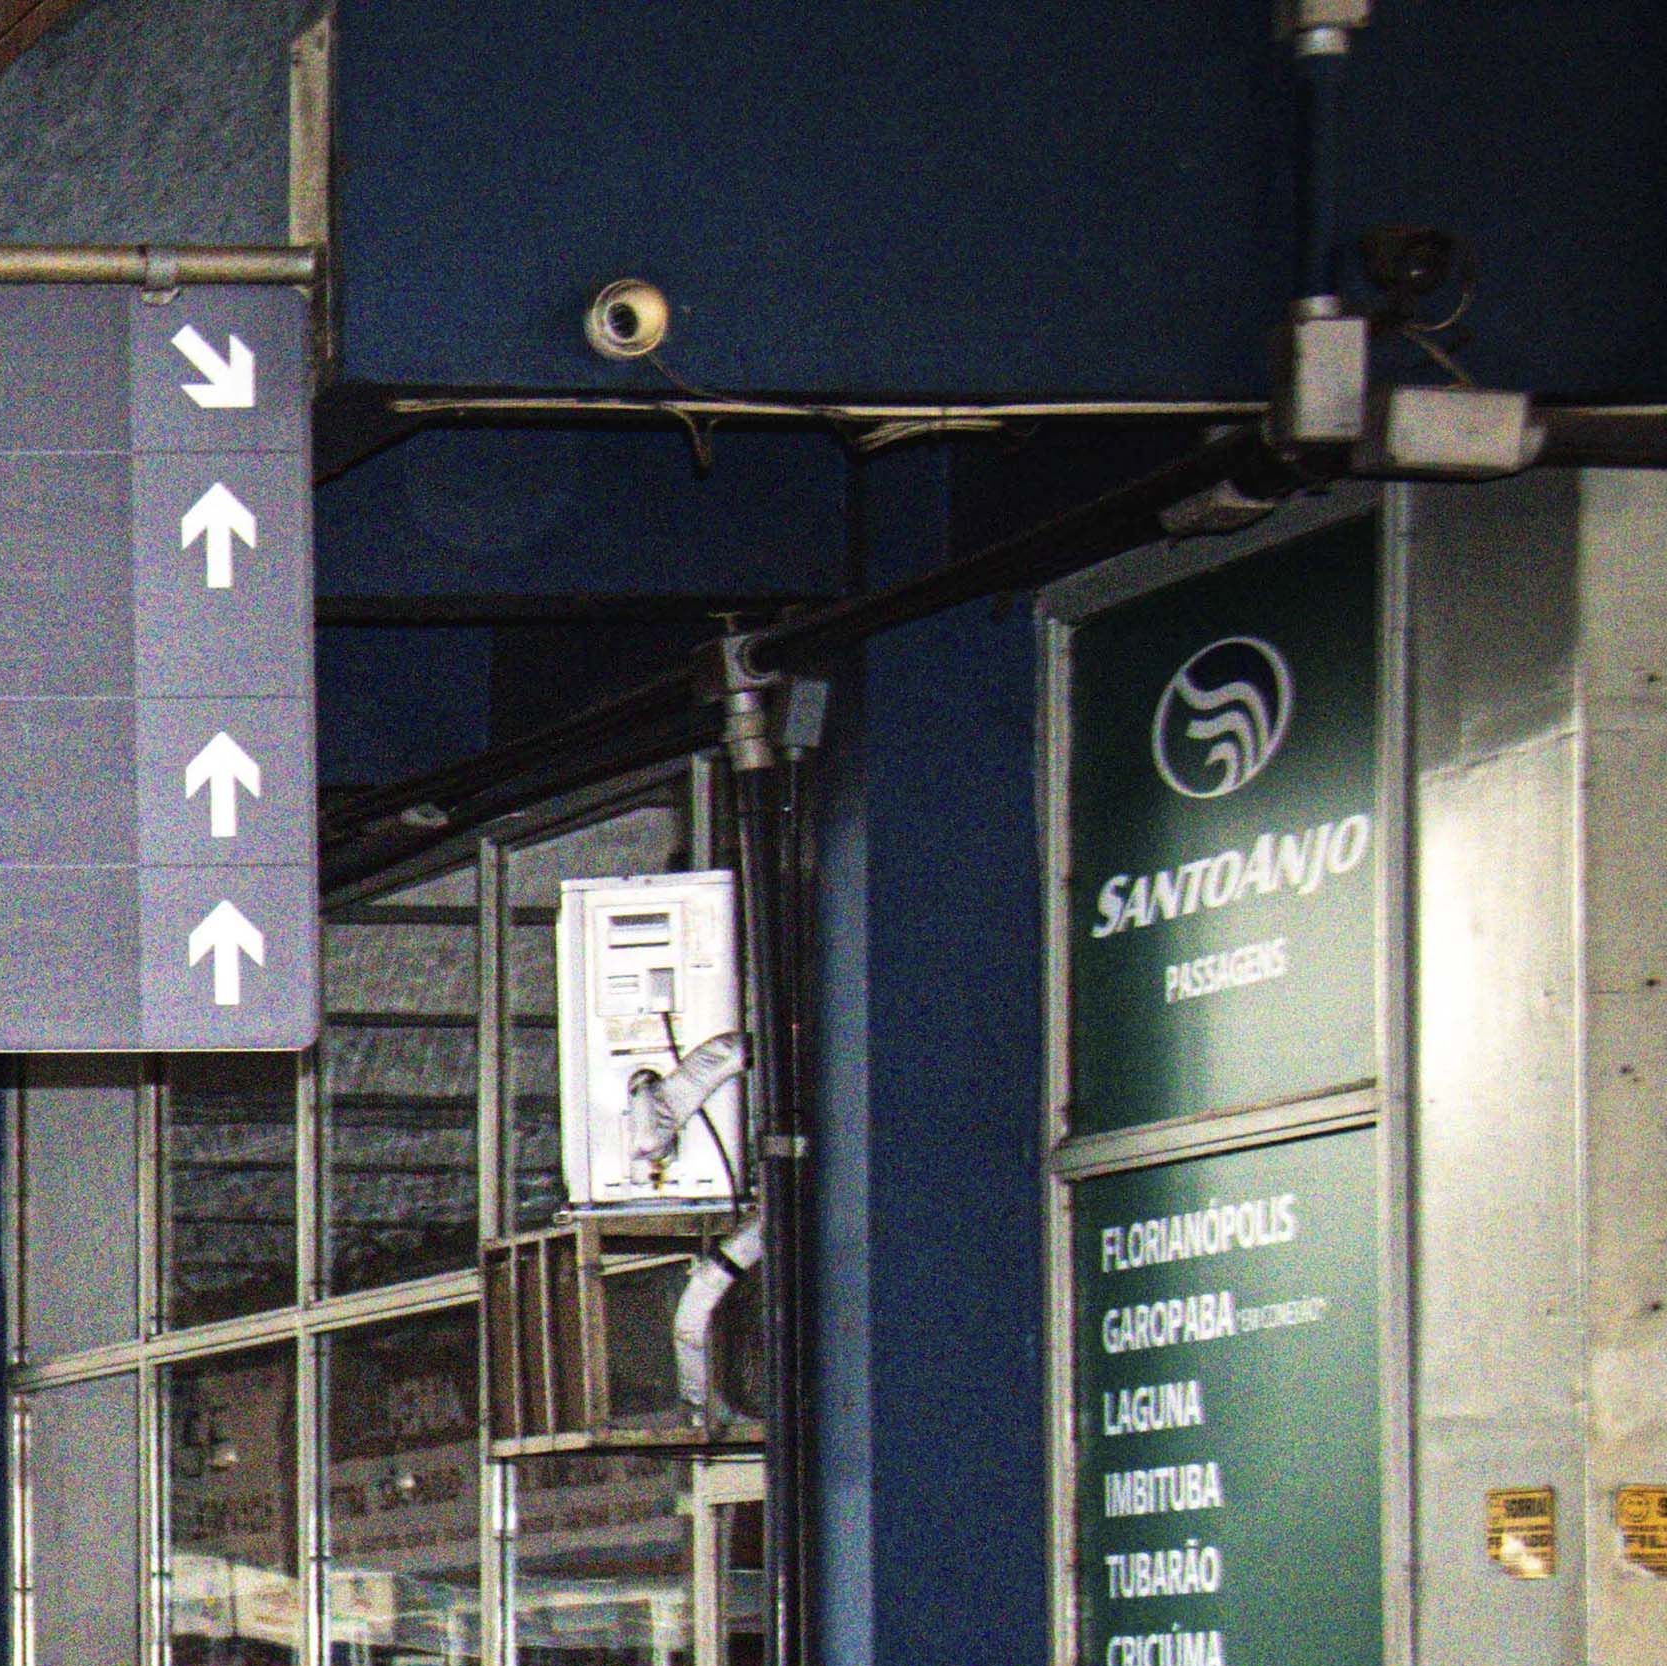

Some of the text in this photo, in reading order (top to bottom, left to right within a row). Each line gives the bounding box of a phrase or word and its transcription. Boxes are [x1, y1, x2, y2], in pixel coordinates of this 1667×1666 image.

[1166, 938, 1285, 1003] PASSAGENS
[1101, 1194, 1296, 1272] FLORIANÓPOLIS
[1102, 1291, 1236, 1354] GAROPABA
[1104, 1380, 1204, 1436] LAGUNA
[1104, 1461, 1224, 1518] IMBITUBA
[1105, 1538, 1223, 1599] TUBARÃO
